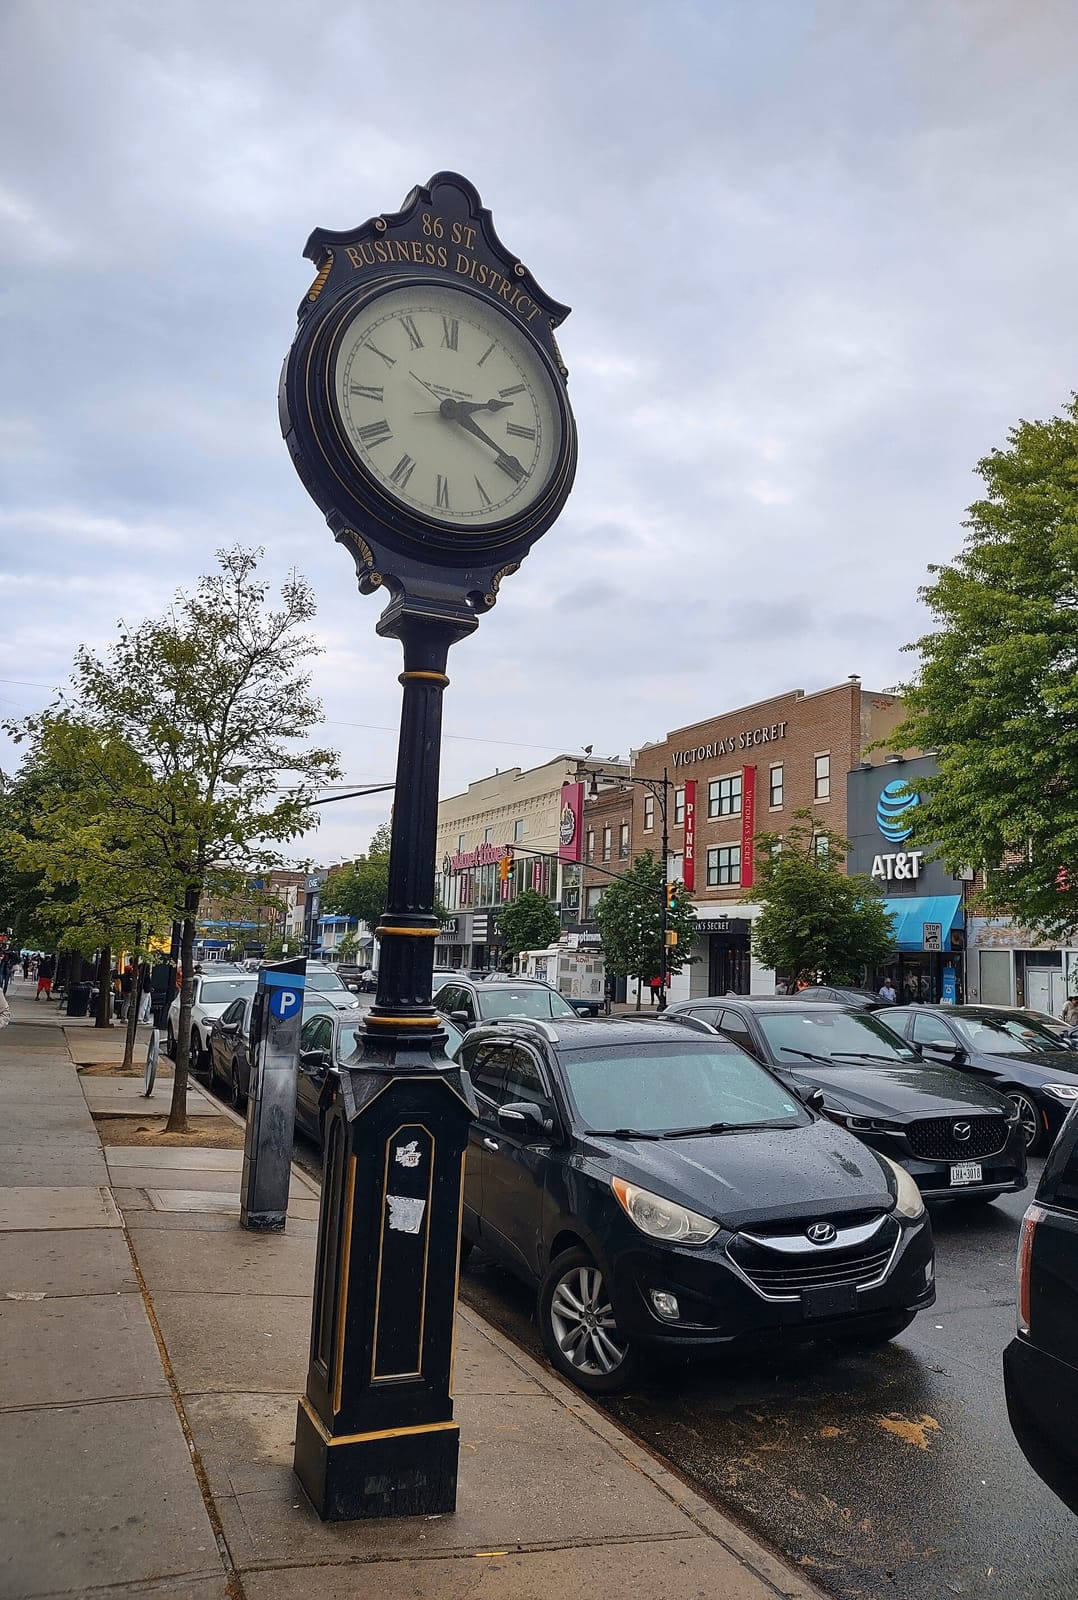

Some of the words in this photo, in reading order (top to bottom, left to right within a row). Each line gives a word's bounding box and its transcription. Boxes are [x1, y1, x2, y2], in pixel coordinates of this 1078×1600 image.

[422, 212, 444, 239] 86
[451, 222, 477, 250] ST.
[344, 240, 448, 270] BUSINESS
[455, 252, 543, 323] DISTRICT
[399, 316, 424, 351] XI
[440, 316, 459, 352] XII
[363, 338, 397, 369] X
[477, 342, 496, 368] I
[350, 379, 384, 404] IX
[498, 383, 527, 398] II
[357, 418, 394, 450] VIII
[506, 421, 536, 441] III
[389, 452, 417, 489] VII
[435, 474, 450, 508] VI
[474, 474, 492, 508] V
[671, 737, 735, 768] VICTORIA'S
[738, 721, 787, 750] SECRET
[686, 803, 694, 859] PINK
[870, 850, 924, 881] AT&T
[707, 921, 729, 930] SECRET
[279, 991, 296, 1014] P
